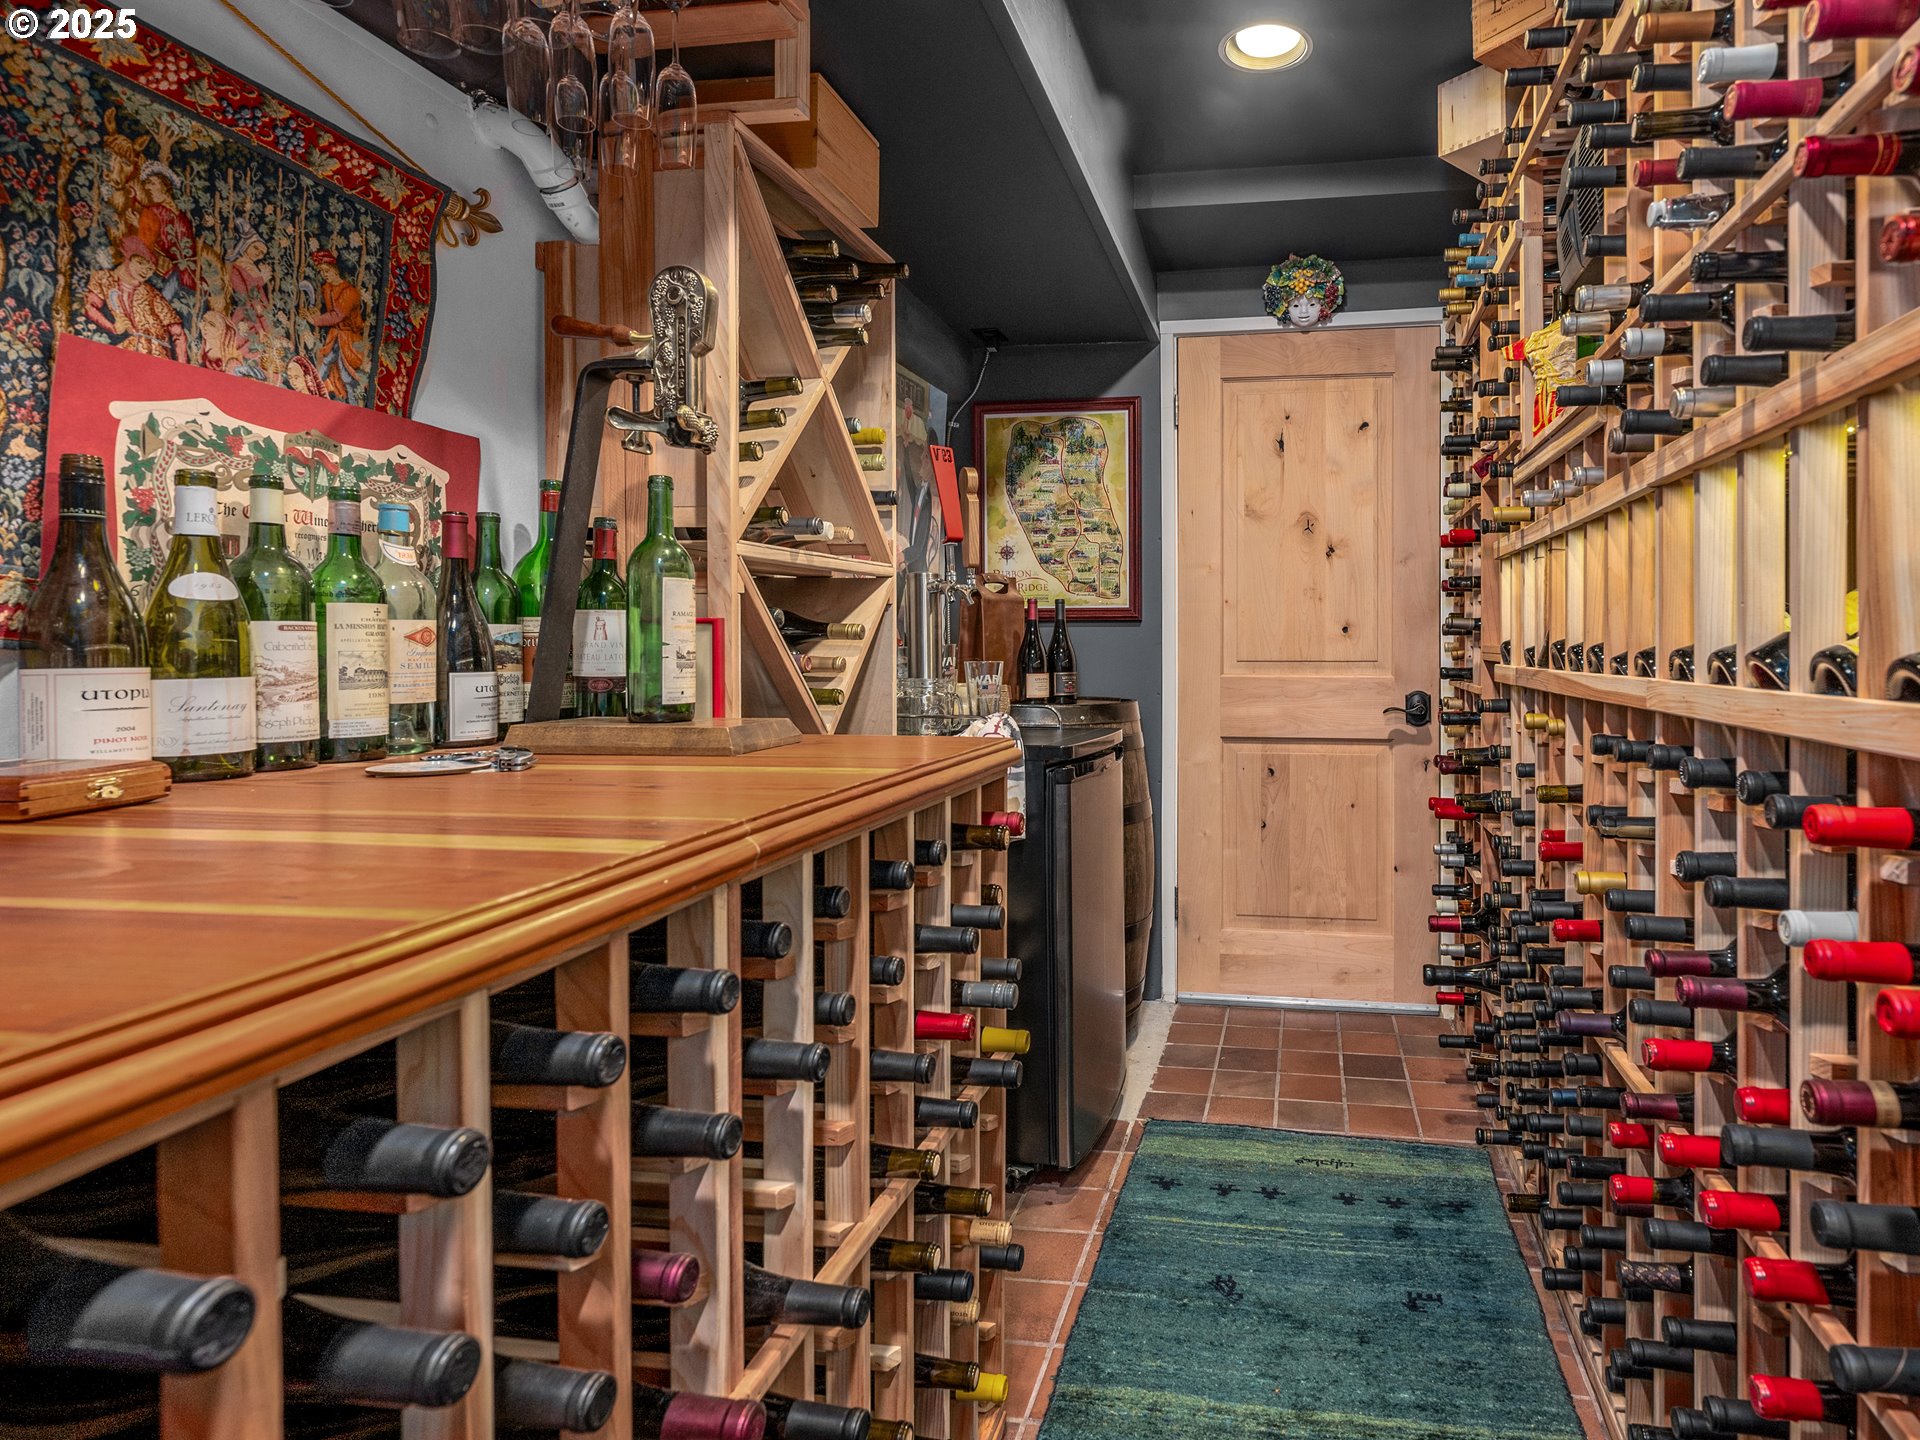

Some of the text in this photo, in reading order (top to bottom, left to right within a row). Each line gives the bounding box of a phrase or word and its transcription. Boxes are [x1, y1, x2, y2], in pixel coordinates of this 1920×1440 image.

[294, 434, 331, 450] Oregon
[217, 501, 237, 517] The
[293, 508, 328, 527] Wine
[1017, 583, 1049, 594] RIDGE
[263, 641, 306, 651] Cabernet
[580, 641, 624, 649] GRAND VIN
[604, 653, 624, 661] LATO
[168, 696, 248, 714] Santenay
[115, 725, 136, 733] 2004
[93, 737, 128, 745] PINOT
